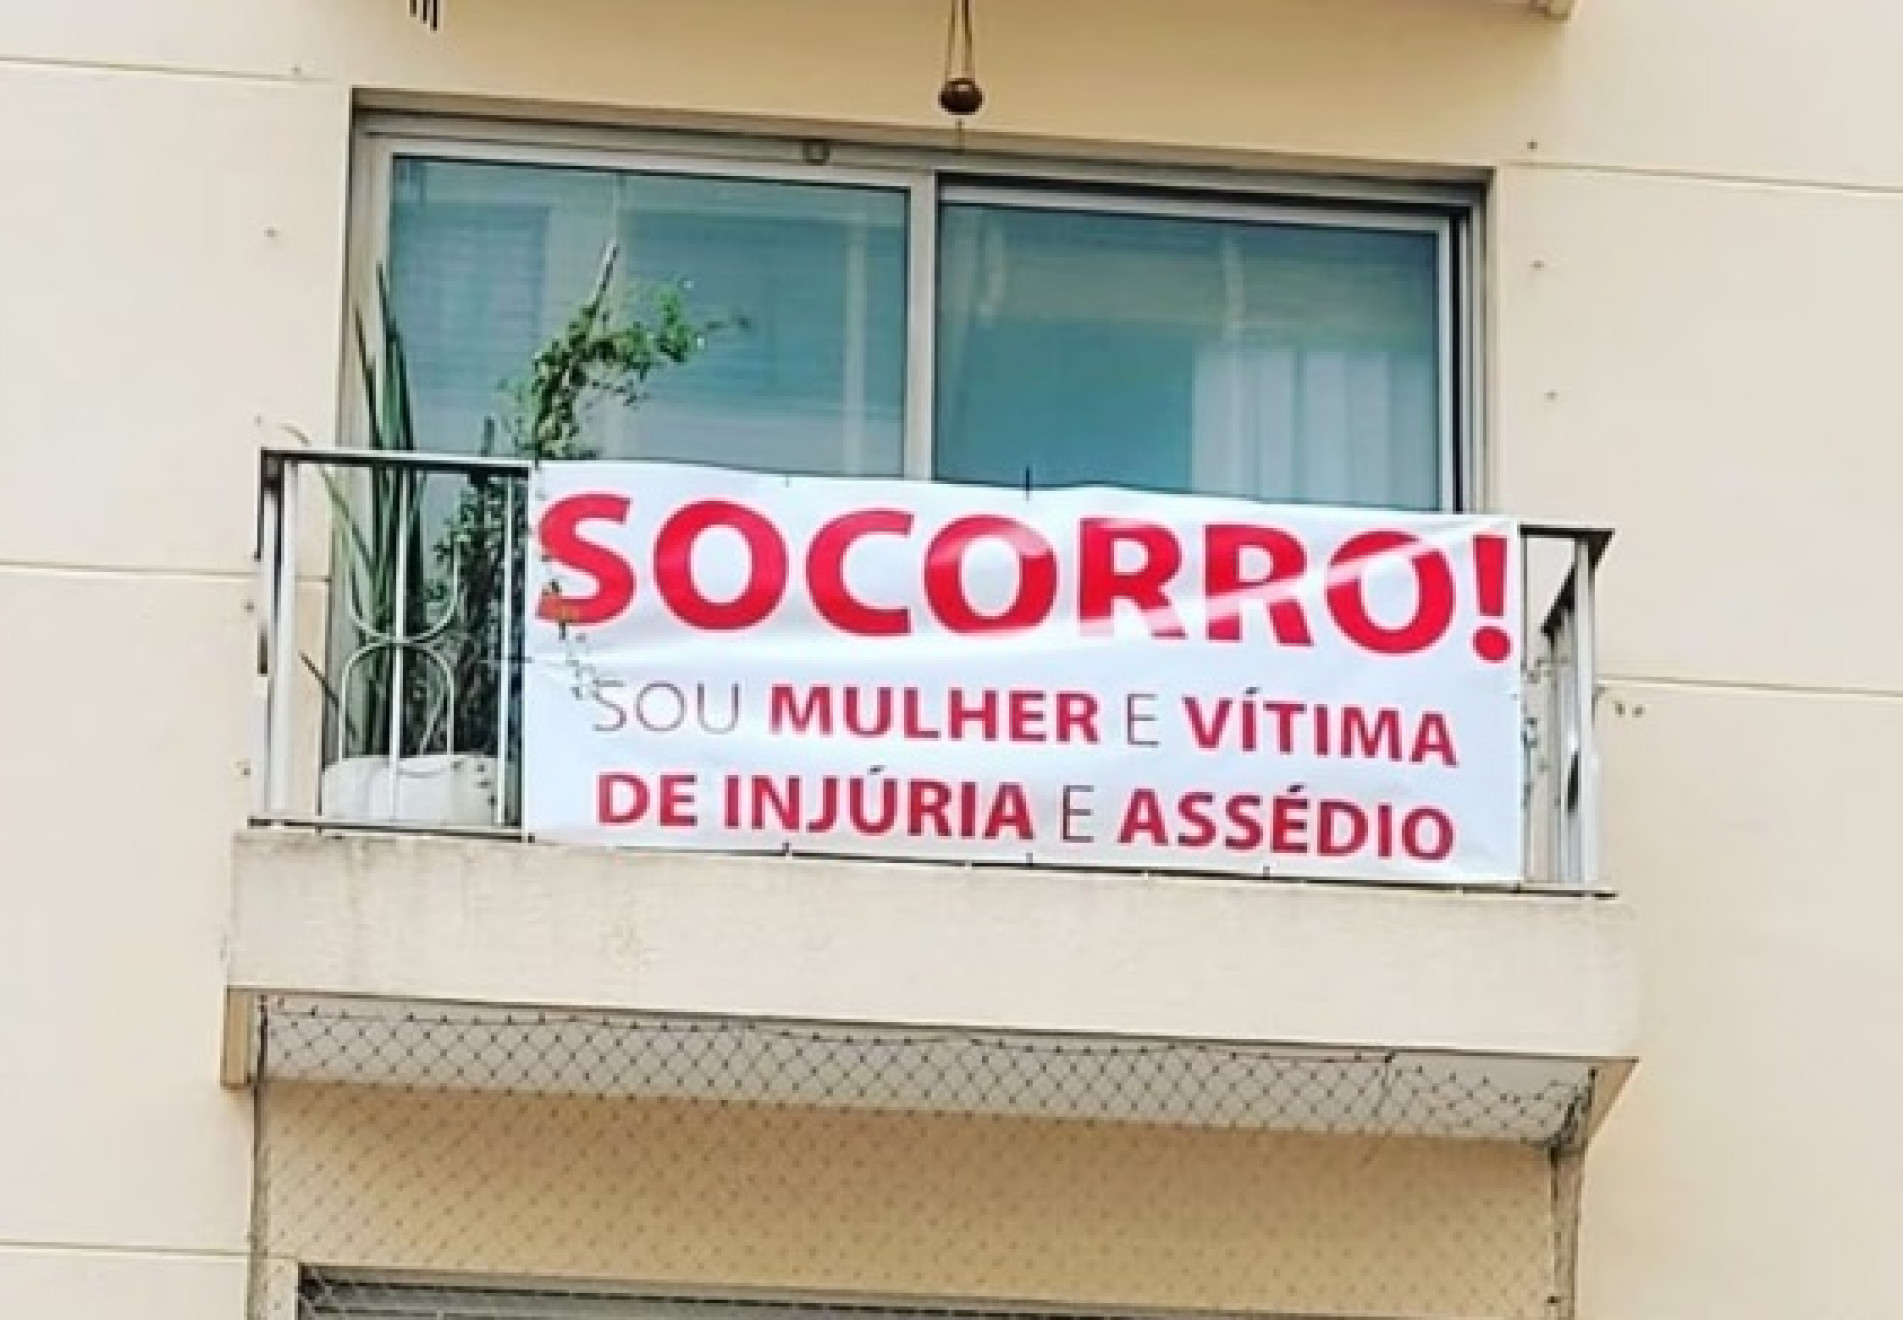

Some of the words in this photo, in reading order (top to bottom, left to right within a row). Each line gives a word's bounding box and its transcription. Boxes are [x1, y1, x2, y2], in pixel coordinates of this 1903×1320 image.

[536, 492, 1512, 663] SOCORRO!
[592, 680, 741, 734] SOU
[769, 684, 1100, 745] MULHER
[1126, 693, 1159, 748] E
[1182, 686, 1458, 767] VÍTIMA
[597, 774, 698, 827] DE
[723, 765, 1036, 840] INJÚRIA
[1062, 785, 1095, 844] E
[1118, 784, 1455, 862] ASSÉDIO
